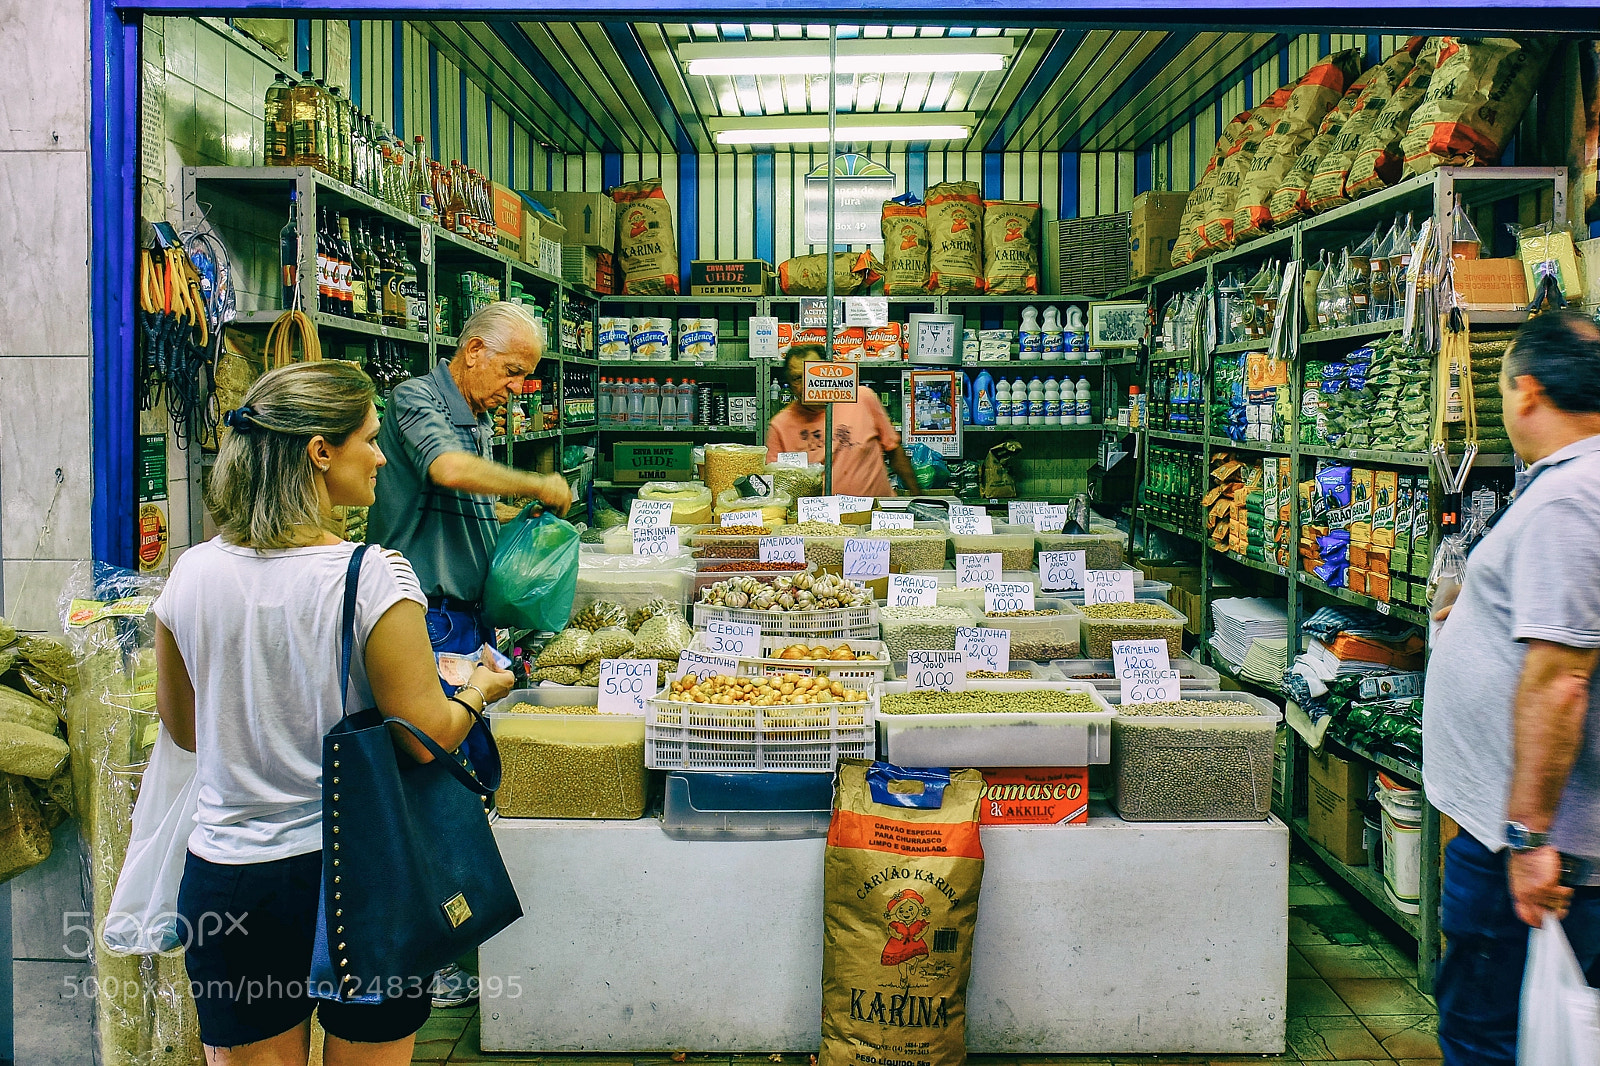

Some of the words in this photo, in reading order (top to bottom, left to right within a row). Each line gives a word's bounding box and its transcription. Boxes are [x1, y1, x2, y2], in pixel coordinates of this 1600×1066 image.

[621, 242, 663, 259] KARINA
[941, 240, 978, 254] KARINA
[994, 249, 1031, 261] KARINA
[891, 259, 928, 272] KARINA
[706, 273, 744, 284] UHDE
[701, 286, 712, 294] ICE
[714, 286, 753, 294] MENTOL
[632, 333, 665, 348] Residence
[680, 332, 713, 347] Residence
[794, 331, 827, 343] Sublime
[865, 331, 898, 342] Sublime
[819, 366, 843, 377] NÃO
[808, 379, 854, 388] ACEITAMOS
[807, 388, 854, 400] CARTÕES.
[632, 456, 674, 467] UHDE
[634, 500, 672, 510] CANJICA
[951, 506, 975, 516] KIBE
[634, 515, 658, 526] 6,00
[720, 512, 758, 522] AMENDOIM
[872, 512, 913, 520] FRADINHO
[633, 527, 676, 537] FARINHA
[633, 535, 667, 543] MANDIOCA
[759, 537, 804, 547] AMENDOIM
[639, 541, 669, 556] 6,00
[845, 539, 890, 552] ROXINHO
[767, 550, 796, 562] 12,00
[858, 552, 879, 561] NOVO
[962, 555, 990, 565] FAVA
[1042, 552, 1077, 563] PRETO
[961, 569, 995, 583] 20,00
[1047, 568, 1075, 584] 6,00
[1086, 571, 1121, 583] JALO
[894, 576, 937, 590] BRANCO
[984, 584, 1031, 594] RAJADO
[900, 587, 923, 595] NOVO
[992, 599, 1024, 612] 10,00
[708, 623, 754, 637] CEBOLA
[956, 627, 1008, 640] ROSINHA
[711, 636, 744, 653] 3,00
[1113, 646, 1160, 655] VERMELHO
[963, 644, 998, 658] 12,00
[680, 650, 736, 669] CEBOLINHA
[908, 651, 962, 665] BOLINHA
[600, 661, 652, 677] PIPOCA
[923, 662, 944, 670] NOVO
[915, 671, 954, 689] 10,00
[1122, 669, 1178, 680] CARIOCA
[604, 678, 643, 695] 5,00
[1130, 685, 1167, 701] 6,00
[633, 694, 645, 709] Kg
[980, 783, 1082, 801] amasco
[874, 823, 905, 834] CARVÃO
[874, 831, 894, 840] PARA
[895, 835, 942, 844] CHURRASCO
[868, 840, 892, 848] LIMPO
[900, 845, 948, 853] GRANULADO
[856, 865, 911, 900] CARVÃO
[914, 869, 961, 909] KARINA
[849, 987, 949, 1029] KARINA
[855, 1053, 877, 1064] PESO
[878, 1058, 915, 1066] LÍQUIDO:
